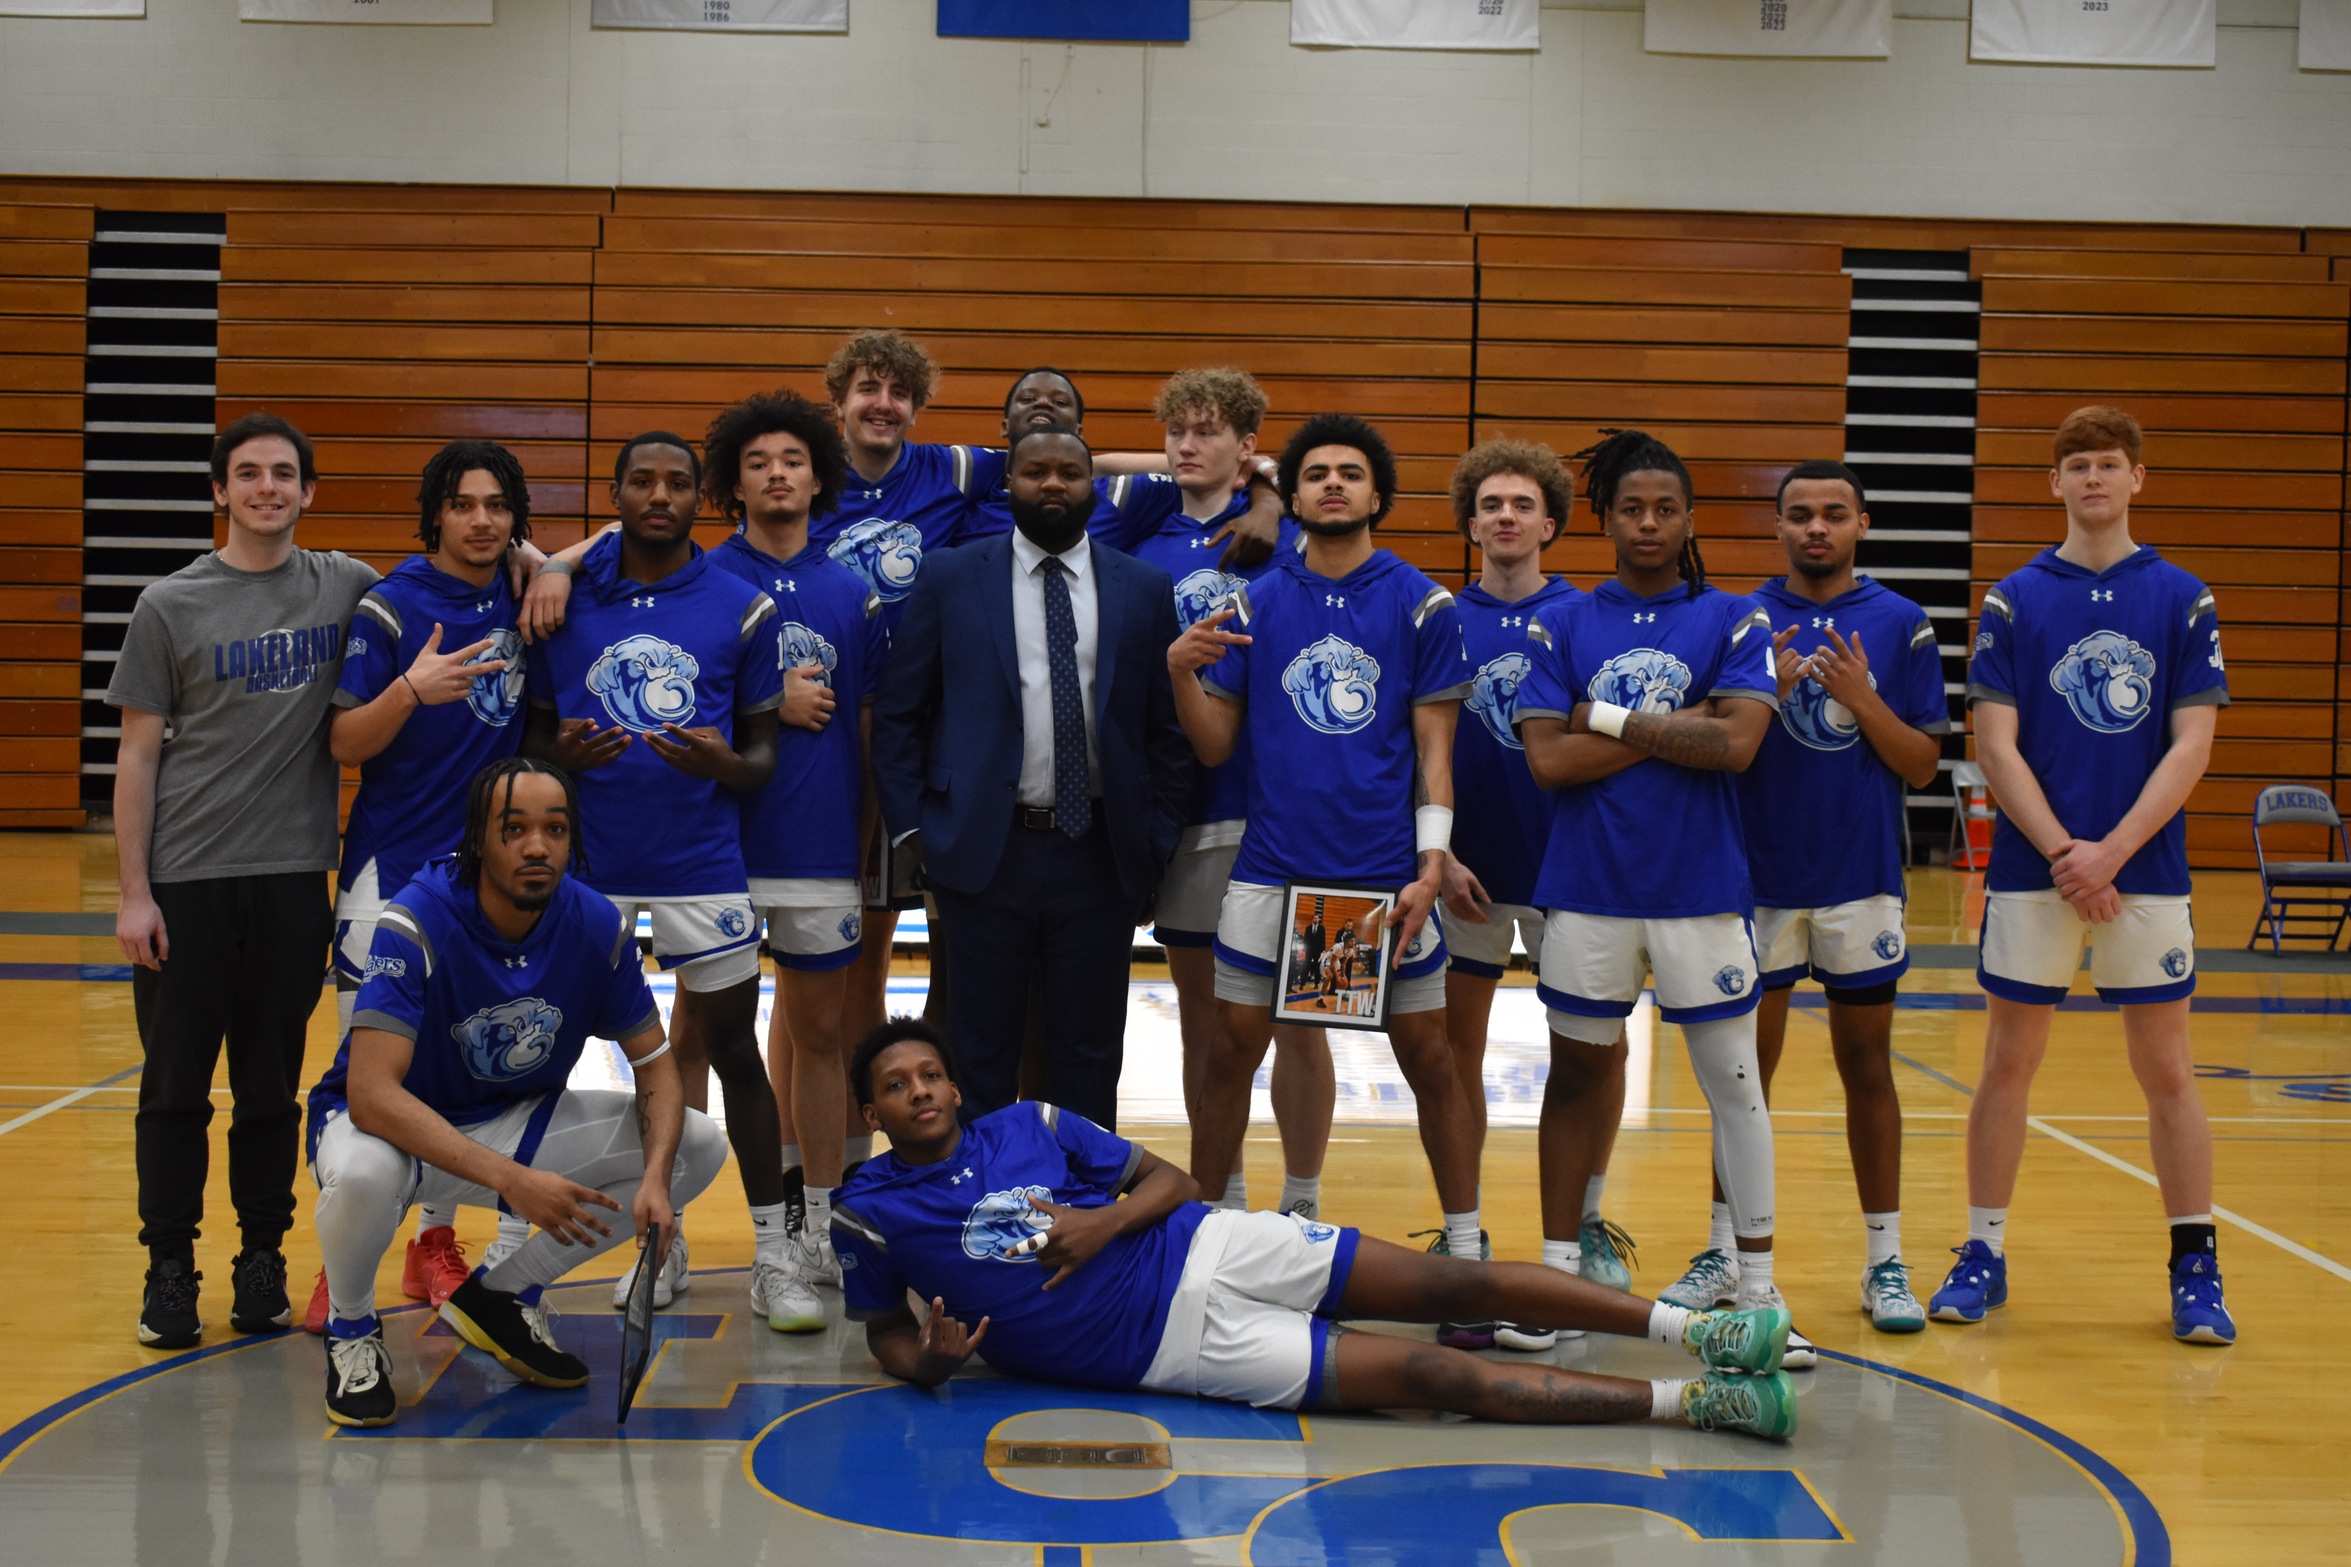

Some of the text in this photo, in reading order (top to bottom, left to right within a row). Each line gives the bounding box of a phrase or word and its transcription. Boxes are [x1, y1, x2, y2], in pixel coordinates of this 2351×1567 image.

[704, 1, 730, 10] 1980
[1478, 6, 1502, 15] 2022
[1761, 3, 1787, 12] 2020
[2082, 1, 2108, 11] 2023
[704, 12, 730, 22] 1986
[215, 623, 339, 682] LAKELAND
[2266, 792, 2328, 812] LAKERS
